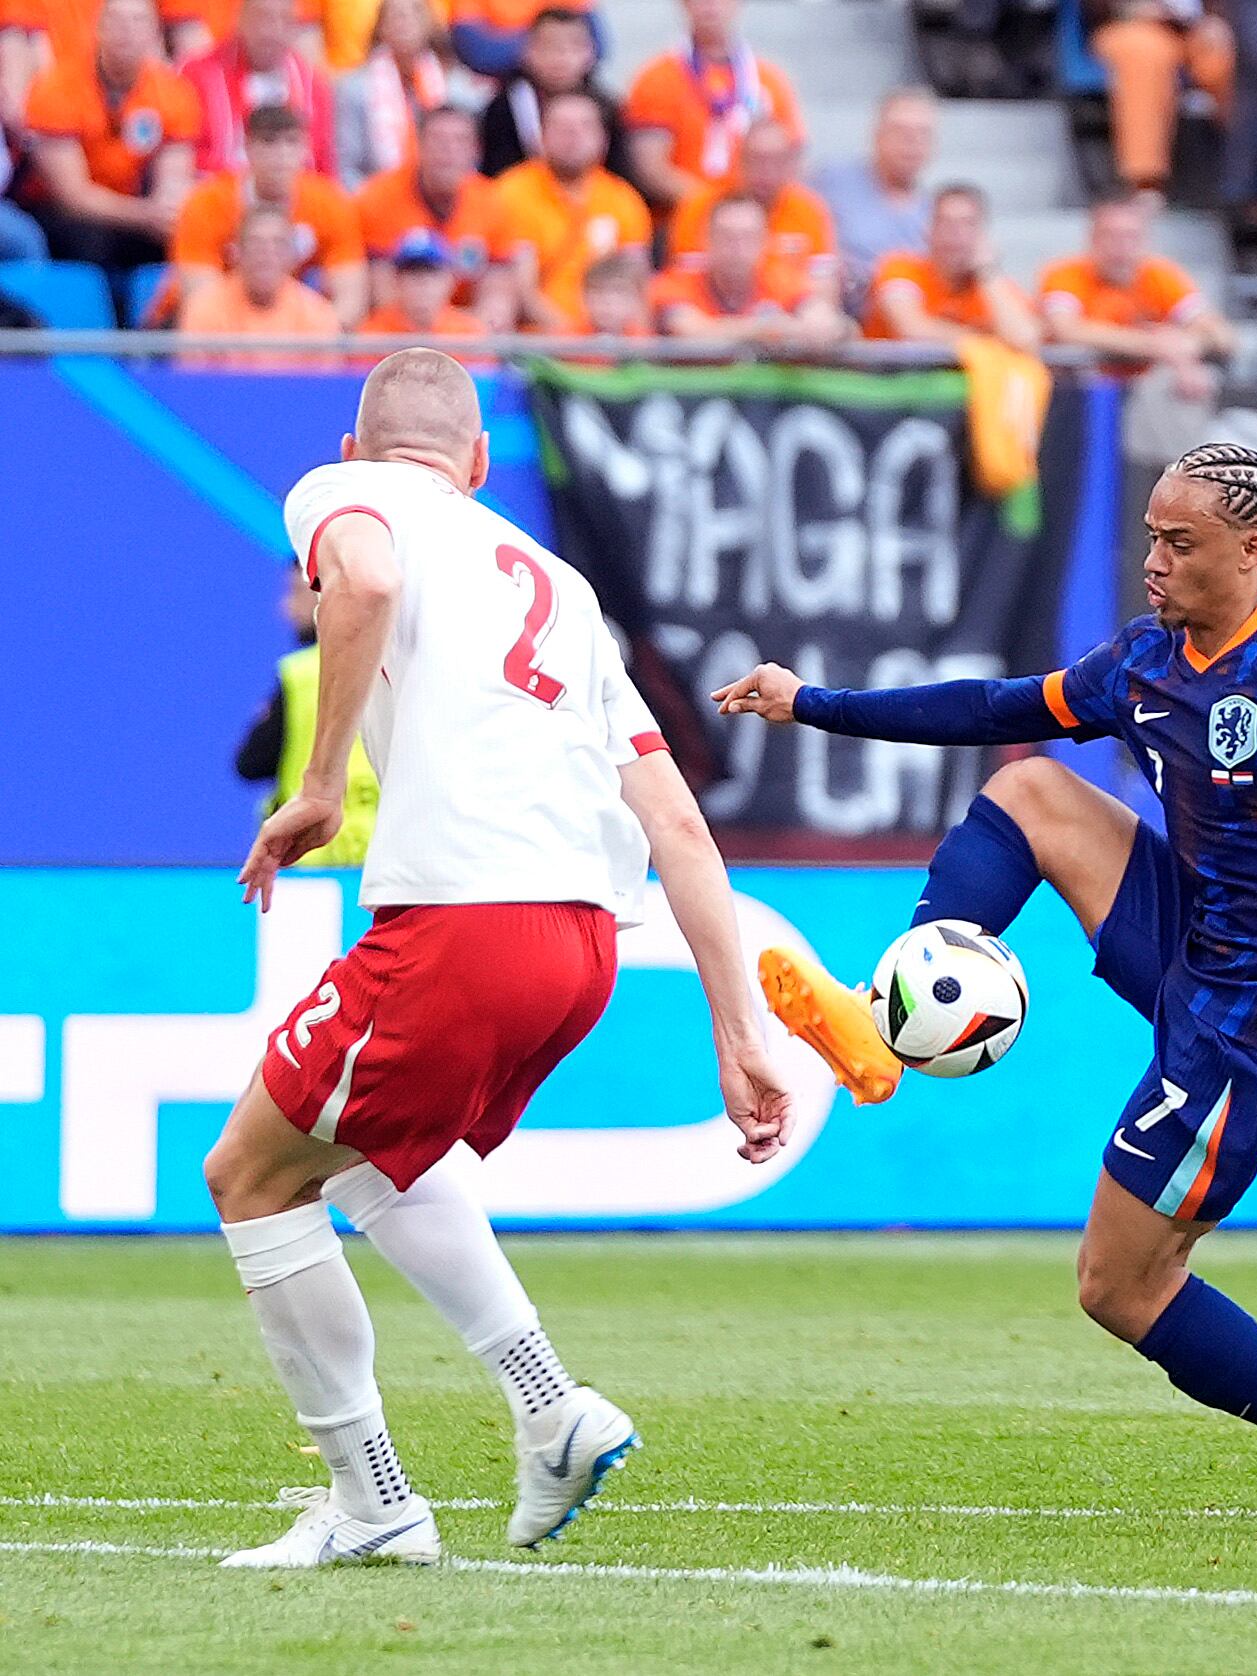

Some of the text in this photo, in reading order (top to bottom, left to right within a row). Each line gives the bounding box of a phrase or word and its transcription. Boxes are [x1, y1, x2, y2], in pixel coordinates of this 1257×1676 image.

[495, 543, 567, 710] 2
[295, 980, 342, 1049] 2
[1134, 1077, 1189, 1132] 7
